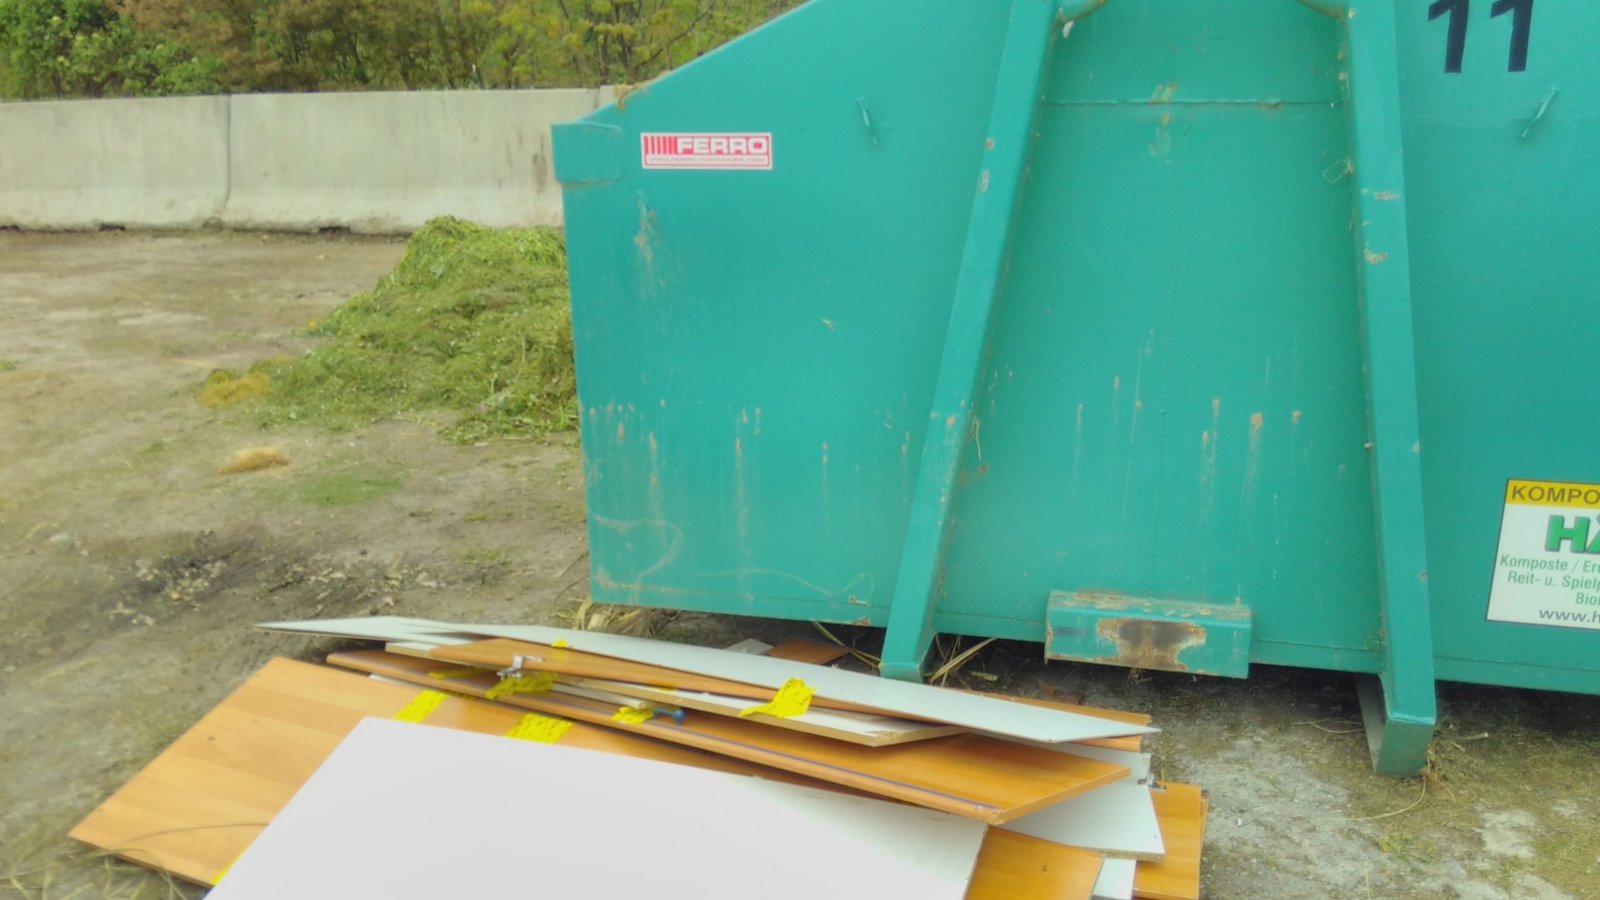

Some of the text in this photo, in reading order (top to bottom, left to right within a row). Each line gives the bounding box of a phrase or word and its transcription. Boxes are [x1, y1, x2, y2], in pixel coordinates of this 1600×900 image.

[1428, 0, 1533, 73] 11
[678, 137, 767, 154] FERRO
[1545, 514, 1600, 554] H
[1500, 554, 1568, 571] Komposte
[1507, 570, 1540, 585] Reit-
[1544, 576, 1557, 587] u.
[1576, 592, 1600, 607] Bio
